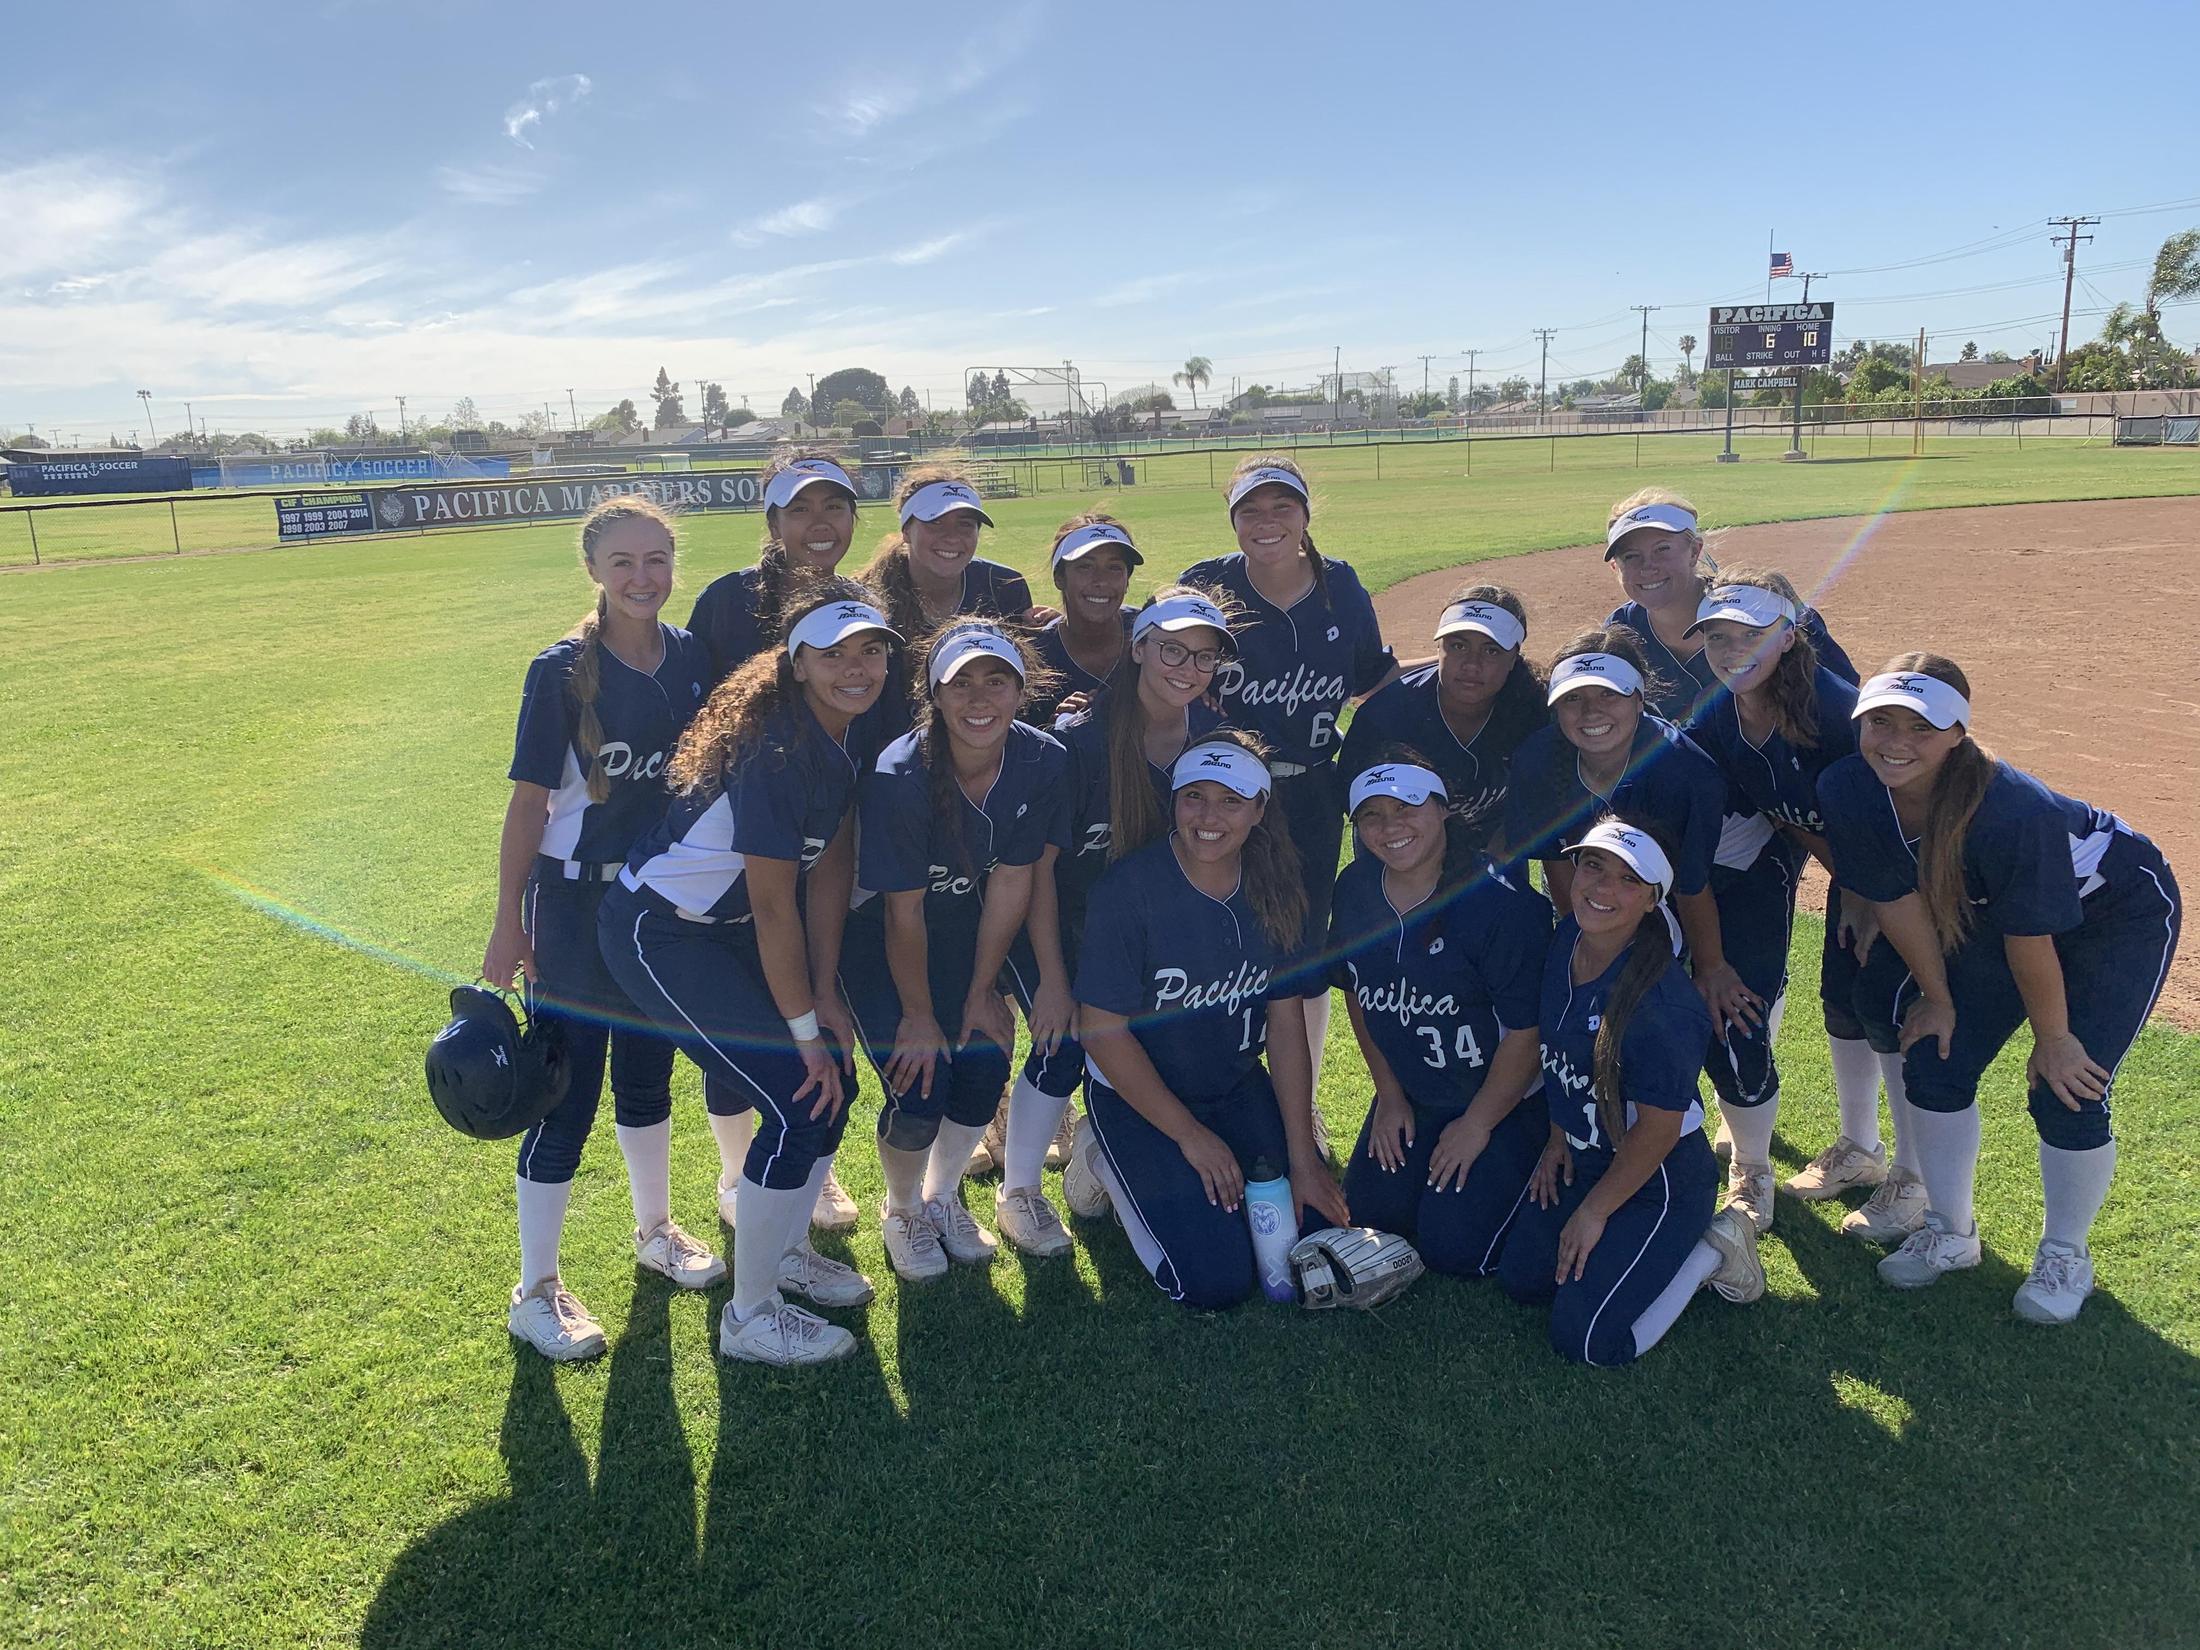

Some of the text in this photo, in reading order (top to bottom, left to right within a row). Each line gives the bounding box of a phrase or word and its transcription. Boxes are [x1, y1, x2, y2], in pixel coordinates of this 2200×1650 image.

[1718, 304, 1824, 323] PACIFICA
[1713, 323, 1820, 335] VISITOR INNING HOME
[1766, 331, 1817, 348] 6 10
[1715, 349, 1827, 361] BALL STRIKE OUT H E
[1734, 377, 1798, 389] MARK CAMPBELL
[41, 461, 138, 473] PACIFICA SOCCER
[271, 459, 428, 480] PACIFICA SOCCER
[281, 494, 363, 508] CIF CHAMPIONS
[412, 487, 553, 521] PACIFICA
[281, 508, 369, 523] 1997 1999 2004 2014
[328, 520, 348, 531] 2007
[1216, 662, 1345, 717] Pacifica
[1309, 711, 1335, 749] 6
[1154, 959, 1273, 1016] Pacific
[1239, 1008, 1267, 1052] 1
[1416, 1024, 1484, 1069] 34
